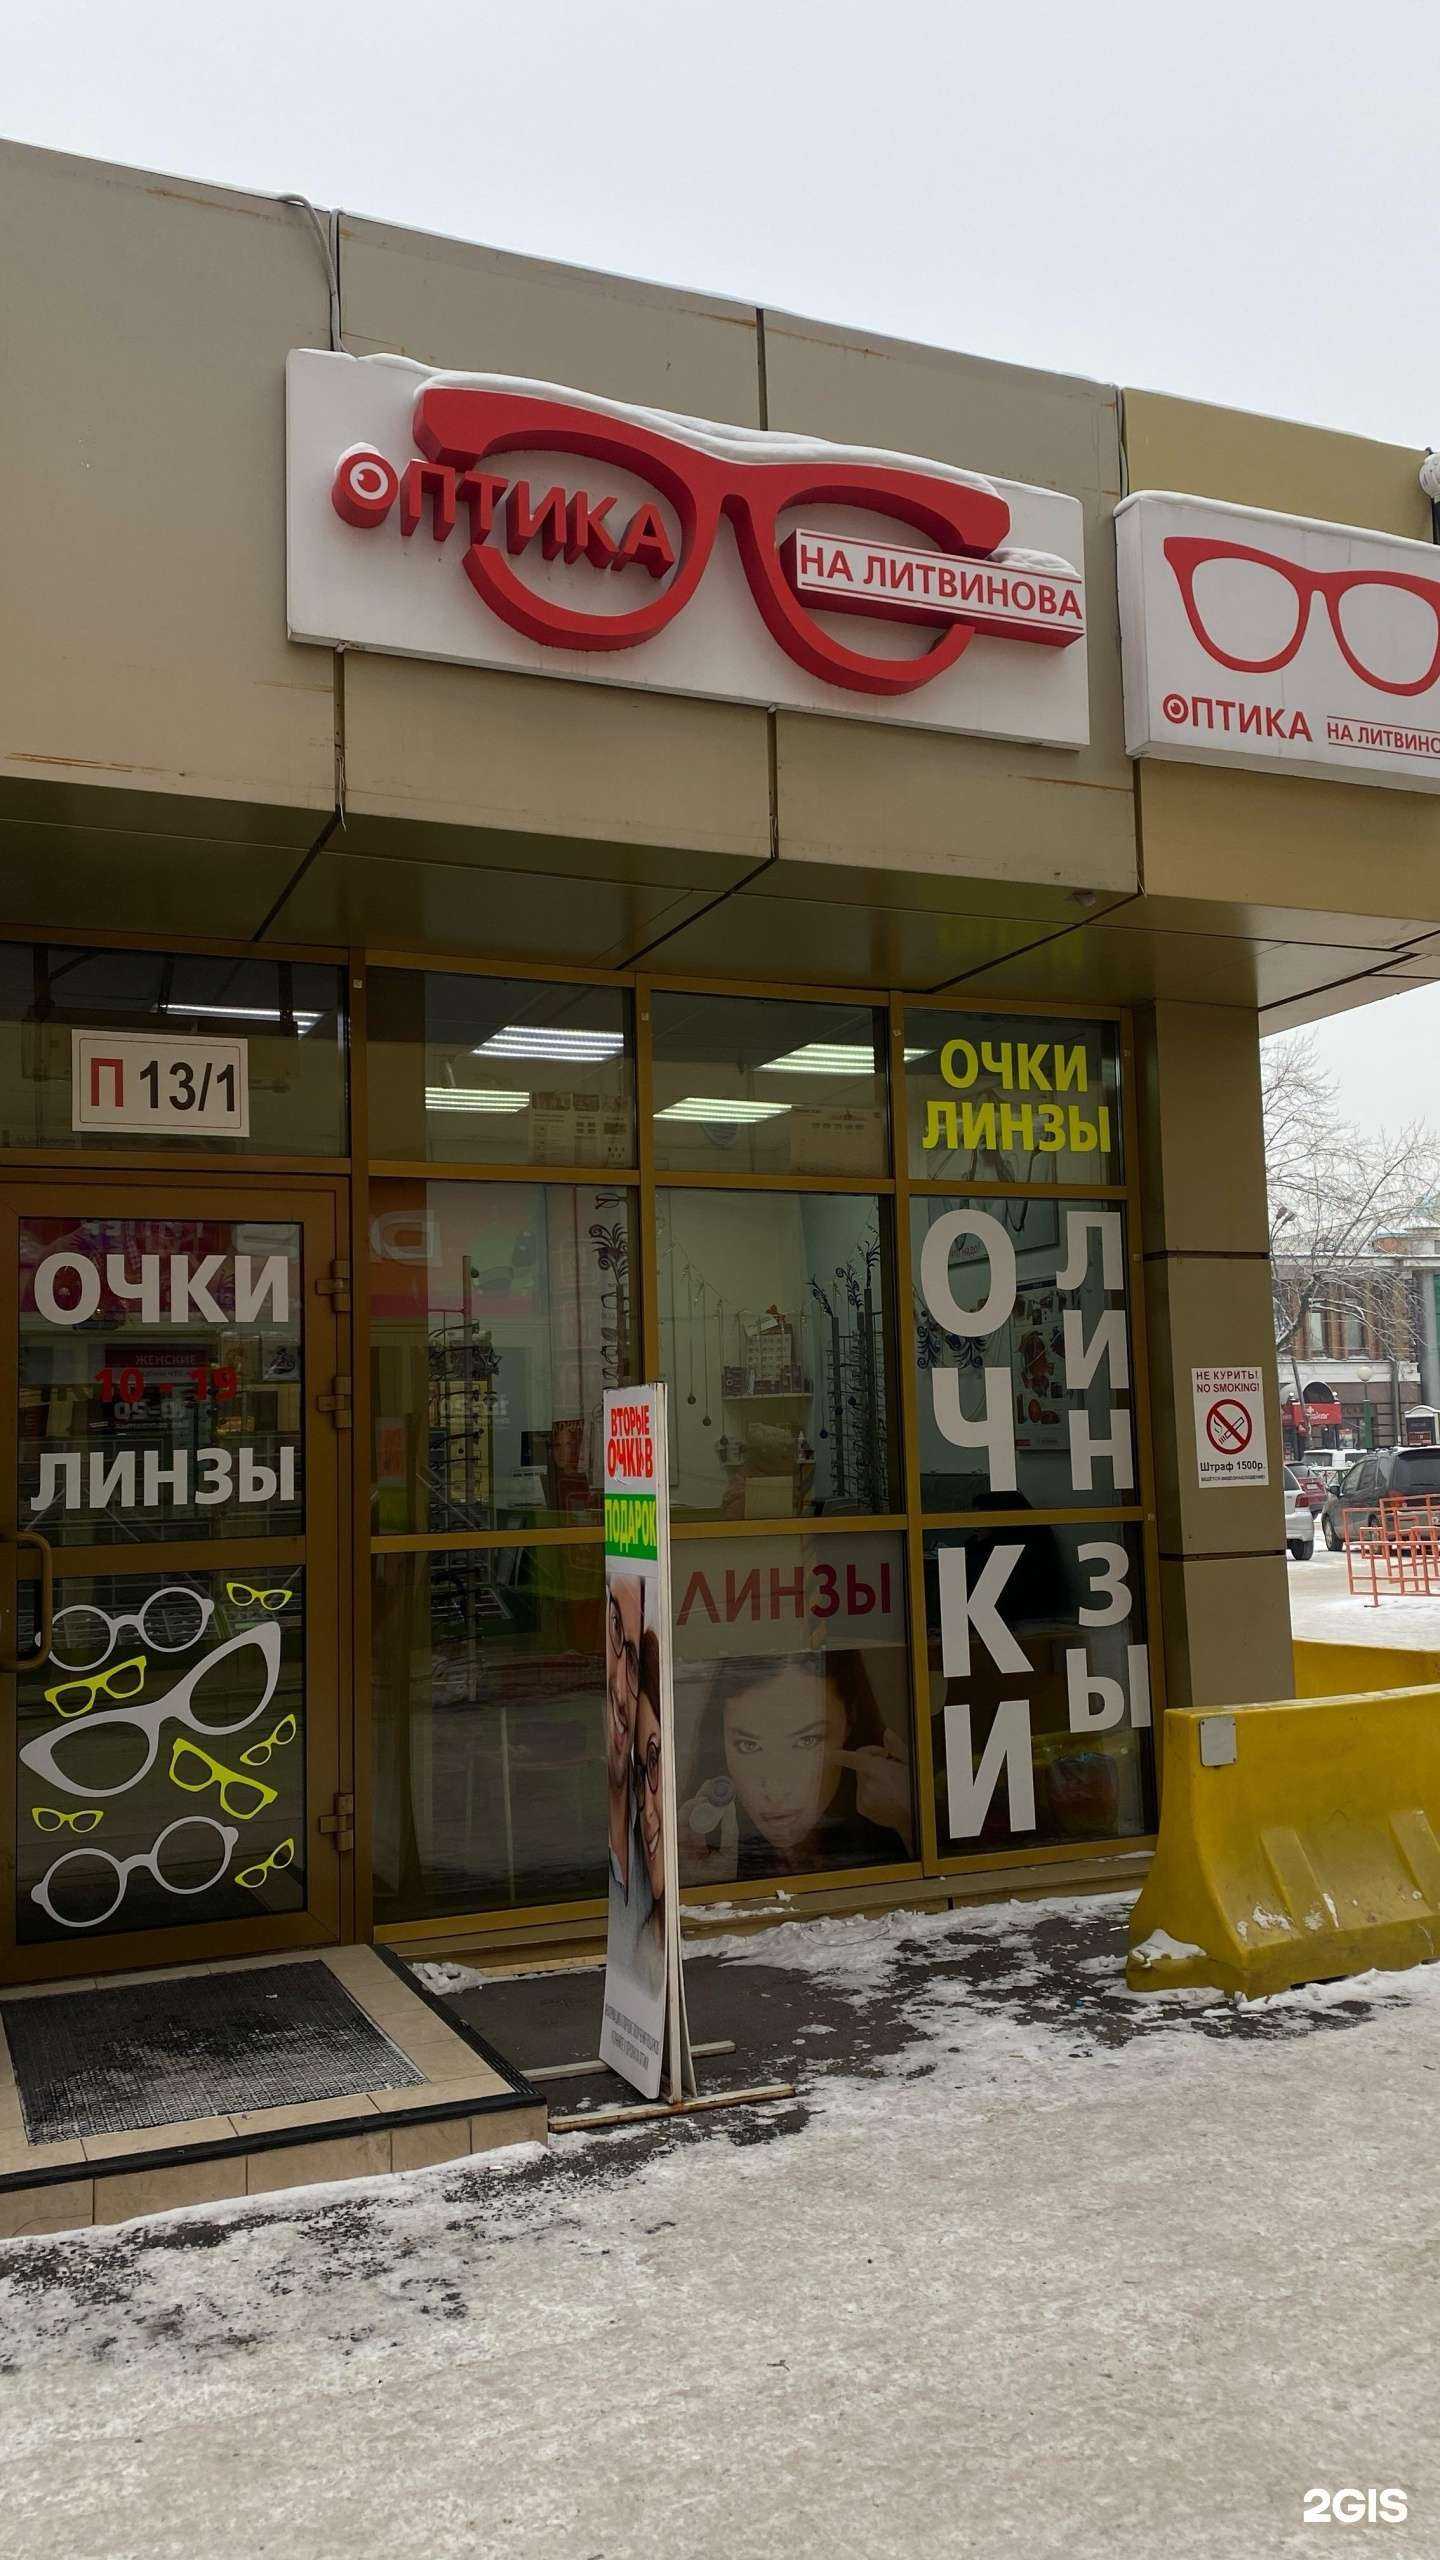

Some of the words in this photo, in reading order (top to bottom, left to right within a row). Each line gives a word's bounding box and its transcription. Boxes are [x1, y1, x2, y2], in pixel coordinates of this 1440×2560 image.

[332, 449, 674, 578] ОПТИКА
[799, 544, 853, 584] НА
[863, 554, 1084, 621] ЛИТВИНОВА
[1163, 693, 1313, 742] ОПТИКА
[1327, 722, 1354, 741] НА
[91, 1059, 123, 1107] П
[139, 1061, 236, 1112] 13/1
[940, 1039, 1088, 1092] ОЧКИ
[922, 1101, 1112, 1153] ЛИНЗЫ
[34, 1252, 289, 1325] ОЧКИ
[95, 1366, 145, 1404] 10
[191, 1365, 238, 1403] 19
[1196, 1371, 1210, 1380] НЕ
[1196, 1383, 1210, 1393] NO
[1213, 1382, 1260, 1393] SMOKING!
[610, 1405, 650, 1437] ВТОРЫЕ
[31, 1447, 295, 1512] ЛИНЗЫ
[607, 1438, 642, 1478] ОЧКИ
[1056, 1211, 1152, 1734] ЛИНЗЫ
[1200, 1462, 1234, 1473] Штраф
[605, 1498, 657, 1553] ПОДАРОК
[920, 1208, 1037, 1839] ОЧКИ
[676, 1561, 893, 1626] ЛИНЗЫ
